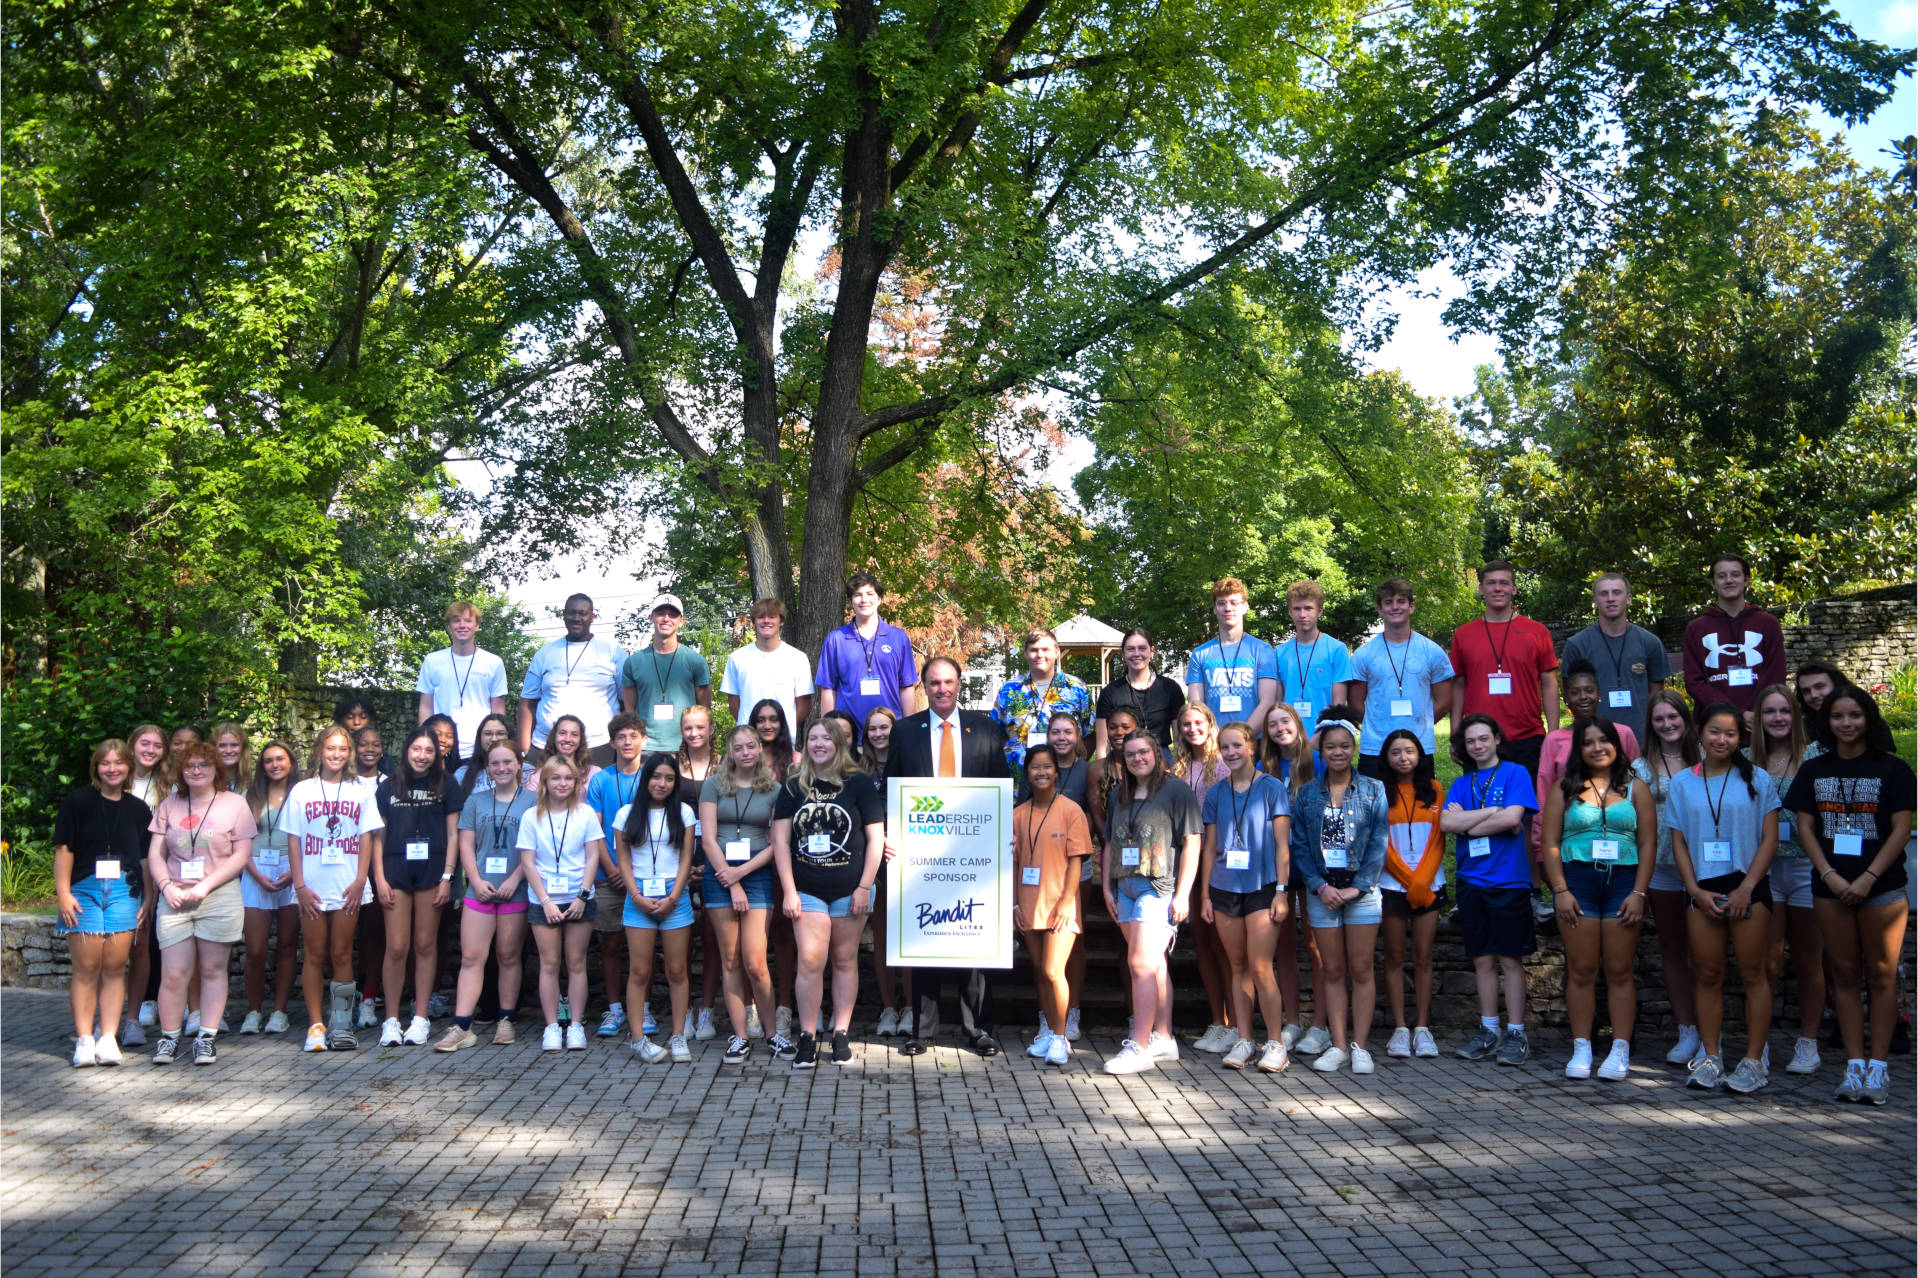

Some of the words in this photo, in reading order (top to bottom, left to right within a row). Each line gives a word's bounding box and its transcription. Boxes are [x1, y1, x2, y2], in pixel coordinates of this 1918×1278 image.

[1205, 667, 1254, 688] VANS
[305, 800, 361, 826] GEORGIA
[909, 813, 993, 825] LEADERSHIP
[909, 825, 981, 836] KNOXVILLE
[909, 857, 956, 867] SUMMER
[960, 857, 992, 867] CAMP
[923, 873, 977, 882] SPONSOR
[915, 897, 985, 930] Bandit
